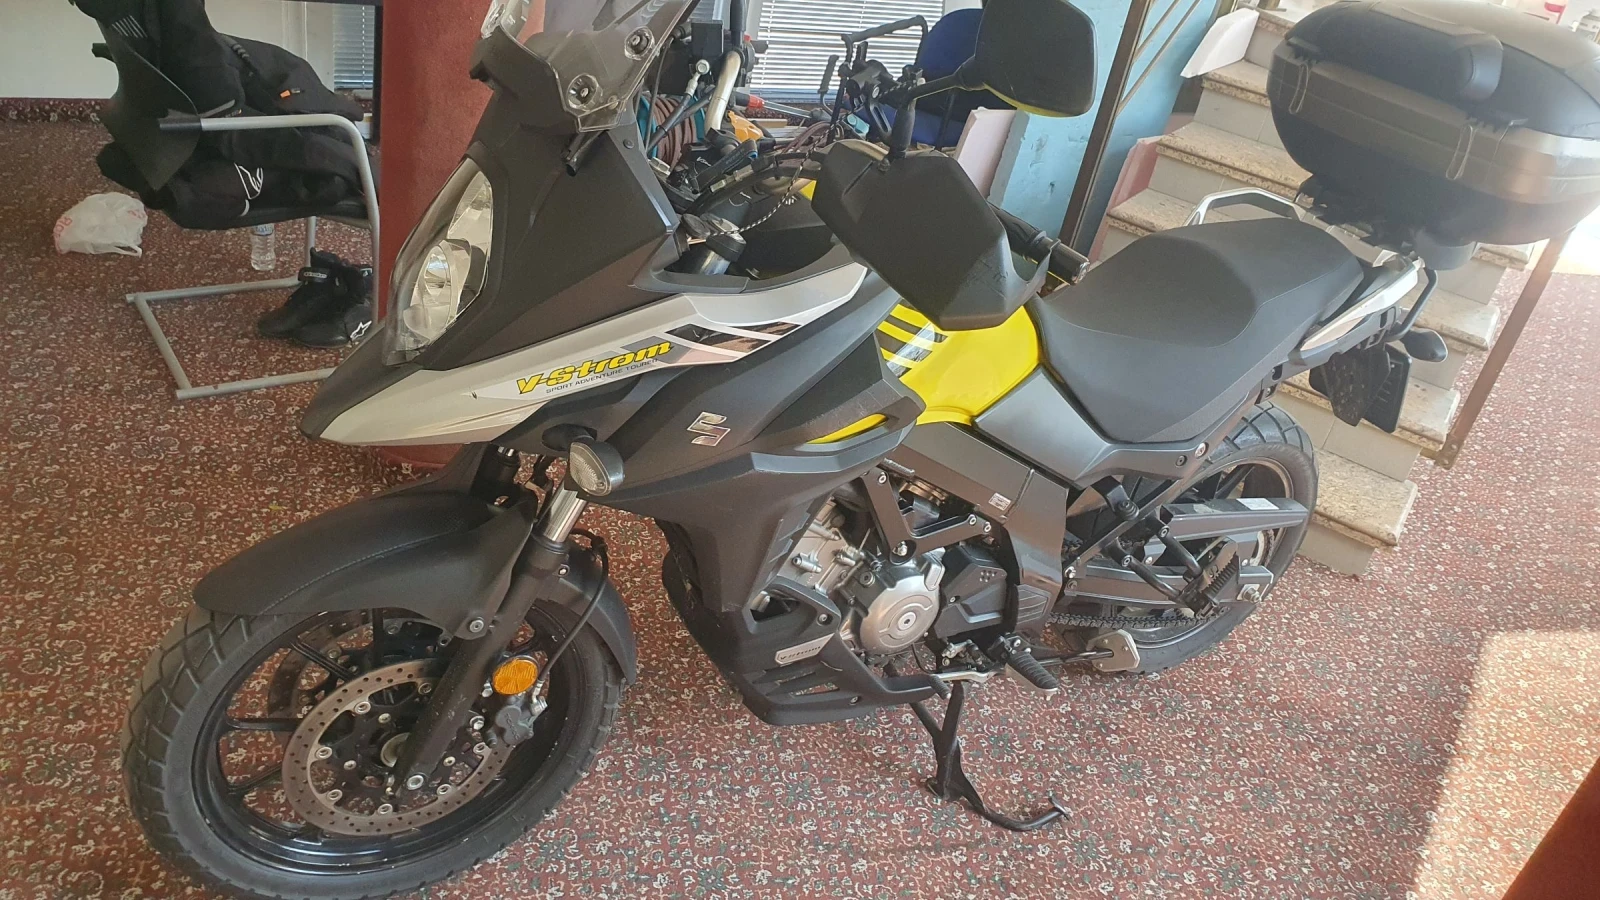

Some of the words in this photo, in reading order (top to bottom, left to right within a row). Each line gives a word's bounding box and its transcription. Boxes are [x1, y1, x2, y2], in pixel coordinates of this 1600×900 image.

[545, 383, 573, 394] SPORT
[575, 368, 624, 386] ADVENTURE
[625, 358, 659, 371] TOURER
